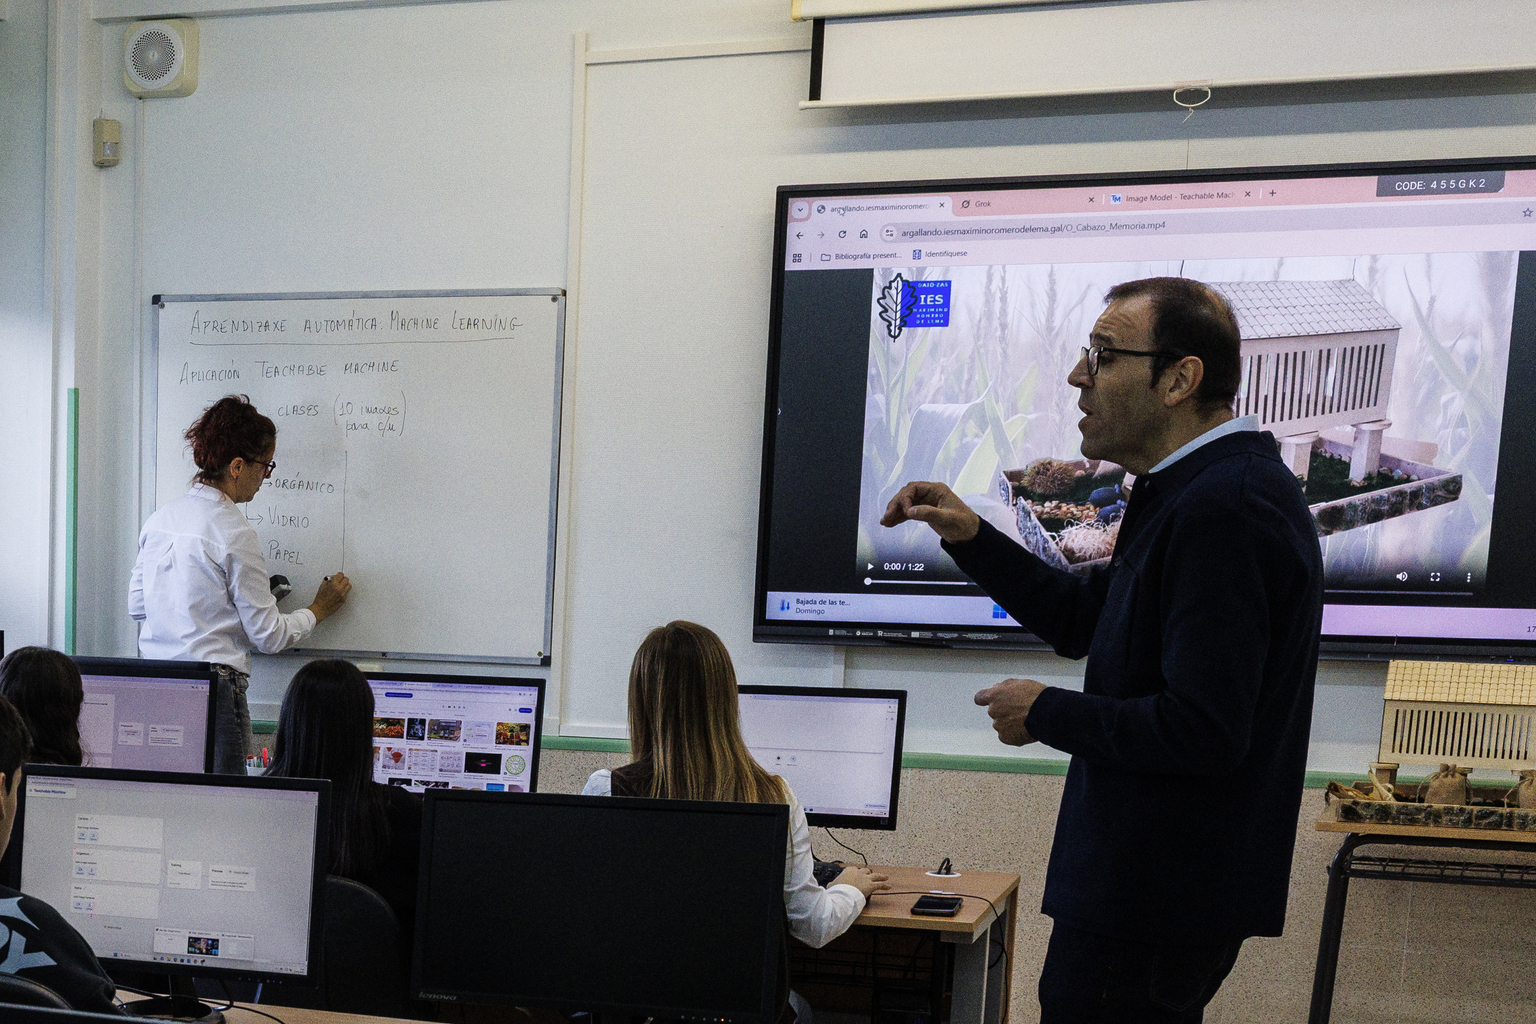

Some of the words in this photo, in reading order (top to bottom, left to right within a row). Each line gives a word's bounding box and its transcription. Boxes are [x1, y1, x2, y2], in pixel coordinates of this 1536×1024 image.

[1395, 181, 1426, 191] CODE:
[1125, 194, 1148, 204] Image
[1149, 193, 1173, 202] Model
[1179, 191, 1215, 201] Teachable
[974, 199, 992, 208] Grok
[919, 294, 944, 305] IES
[390, 310, 439, 331] MACHINE
[451, 309, 524, 331] LEARNING
[277, 404, 320, 417] CLASES
[268, 505, 310, 529] VIDRIO
[267, 539, 304, 566] PAPEL
[883, 562, 902, 571] 0:00
[907, 563, 925, 571] 1:22
[795, 597, 817, 607] Bajada
[818, 598, 828, 606] de
[828, 598, 838, 606] las
[795, 607, 826, 616] Domingo
